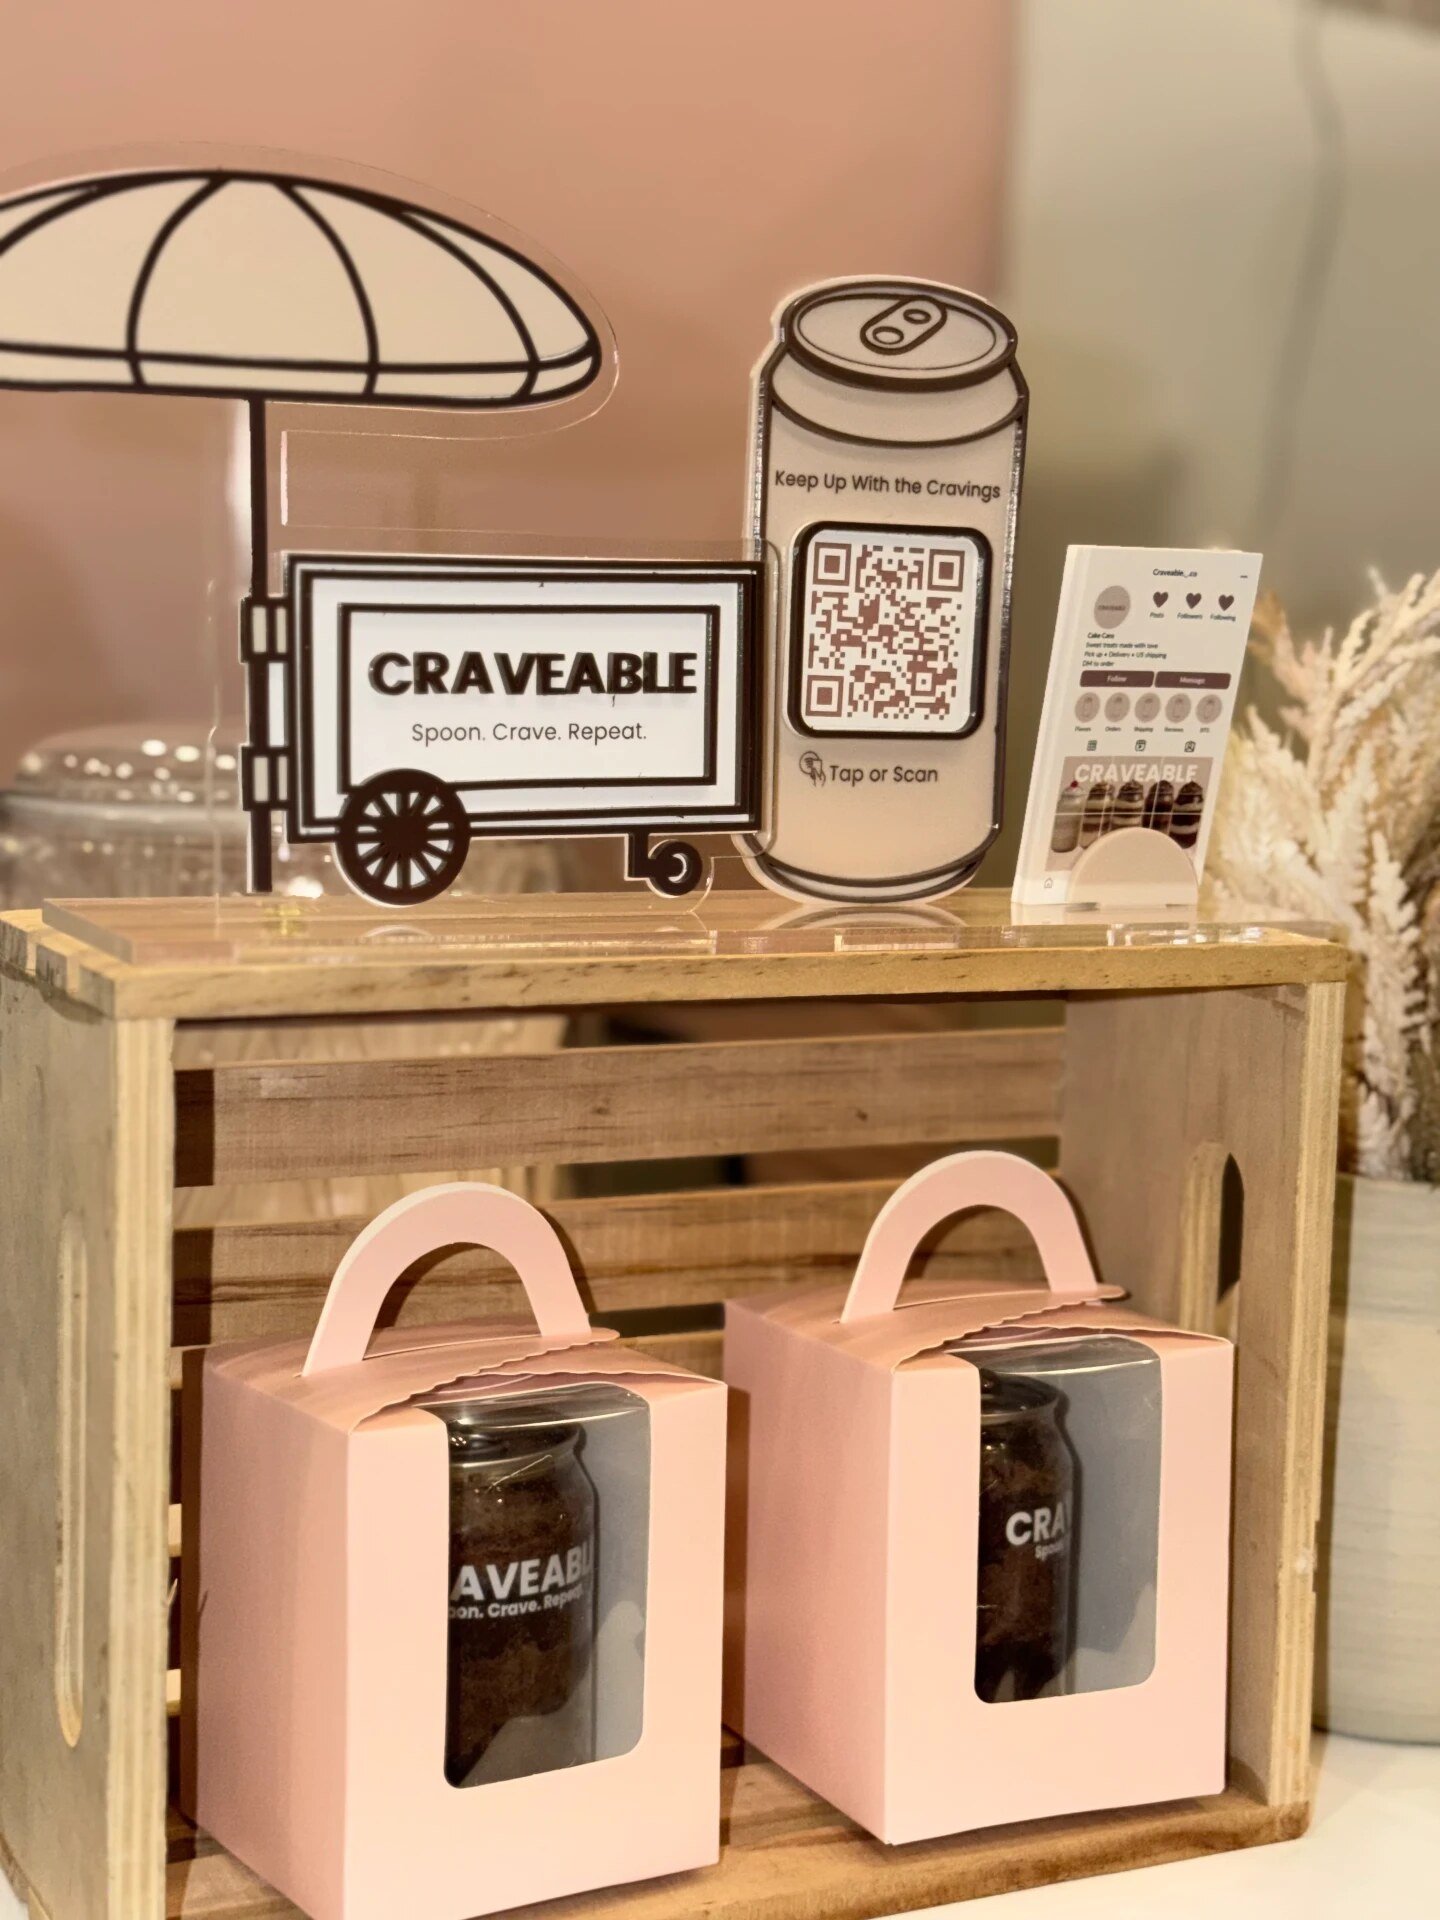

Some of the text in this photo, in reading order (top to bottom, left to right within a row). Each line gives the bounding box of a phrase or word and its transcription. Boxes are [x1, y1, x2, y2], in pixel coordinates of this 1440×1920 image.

[775, 470, 1001, 502] Keep Up With the Cravings
[1210, 614, 1236, 622] Following
[1109, 651, 1130, 659] Delivery
[368, 651, 698, 696] CRAVEABLE
[1179, 676, 1206, 685] Message
[411, 723, 647, 747] Spoon. Crave. Repeat.
[829, 765, 938, 787] Tap or Scan
[1074, 763, 1198, 783] CRAVEABLE
[450, 1539, 593, 1602] AVEABL
[488, 1602, 542, 1617] Crave.
